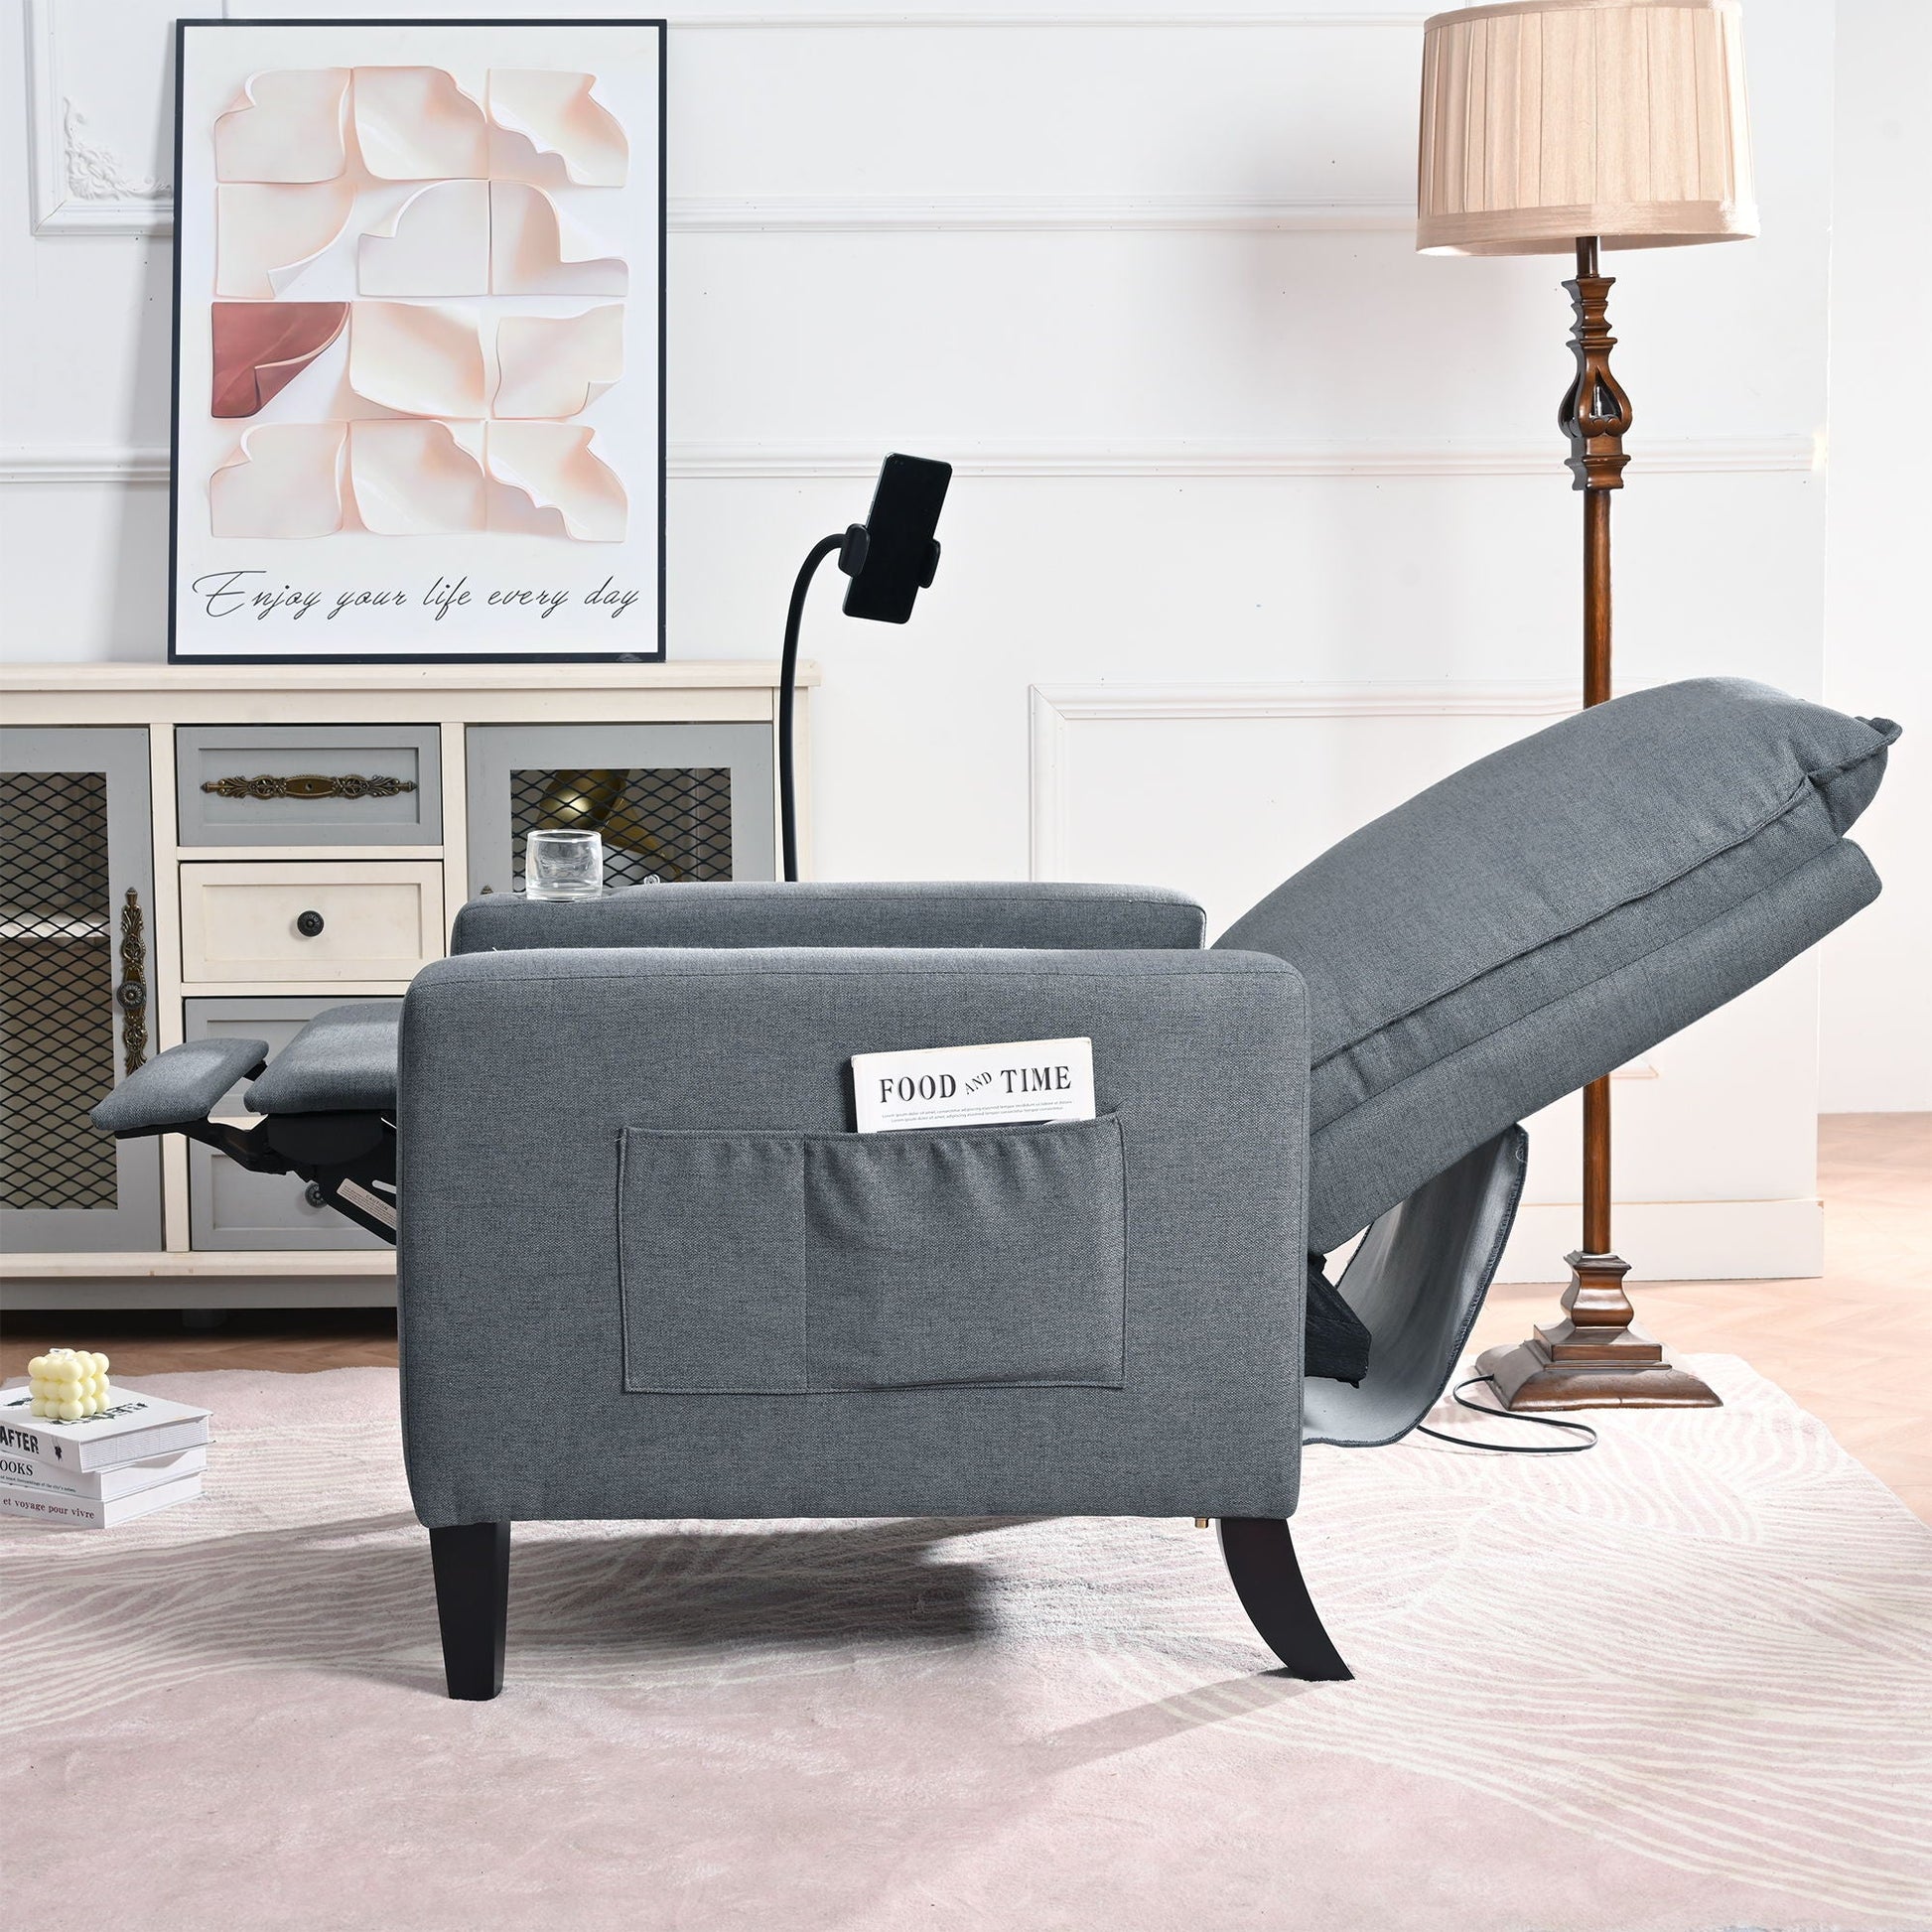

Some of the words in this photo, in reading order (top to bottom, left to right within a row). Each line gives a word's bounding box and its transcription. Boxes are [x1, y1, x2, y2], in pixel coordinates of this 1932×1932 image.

[192, 570, 322, 621] Enjoy
[327, 591, 407, 621] your
[422, 576, 472, 621] life
[487, 590, 570, 620] every
[584, 575, 639, 619] day
[880, 1073, 957, 1103] FOOD
[965, 1071, 992, 1095] AND
[1000, 1065, 1072, 1094] TIME
[0, 1426, 40, 1454] AFTER
[15, 1500, 46, 1511] voyage
[49, 1505, 69, 1514] pour
[71, 1508, 95, 1519] vivre
